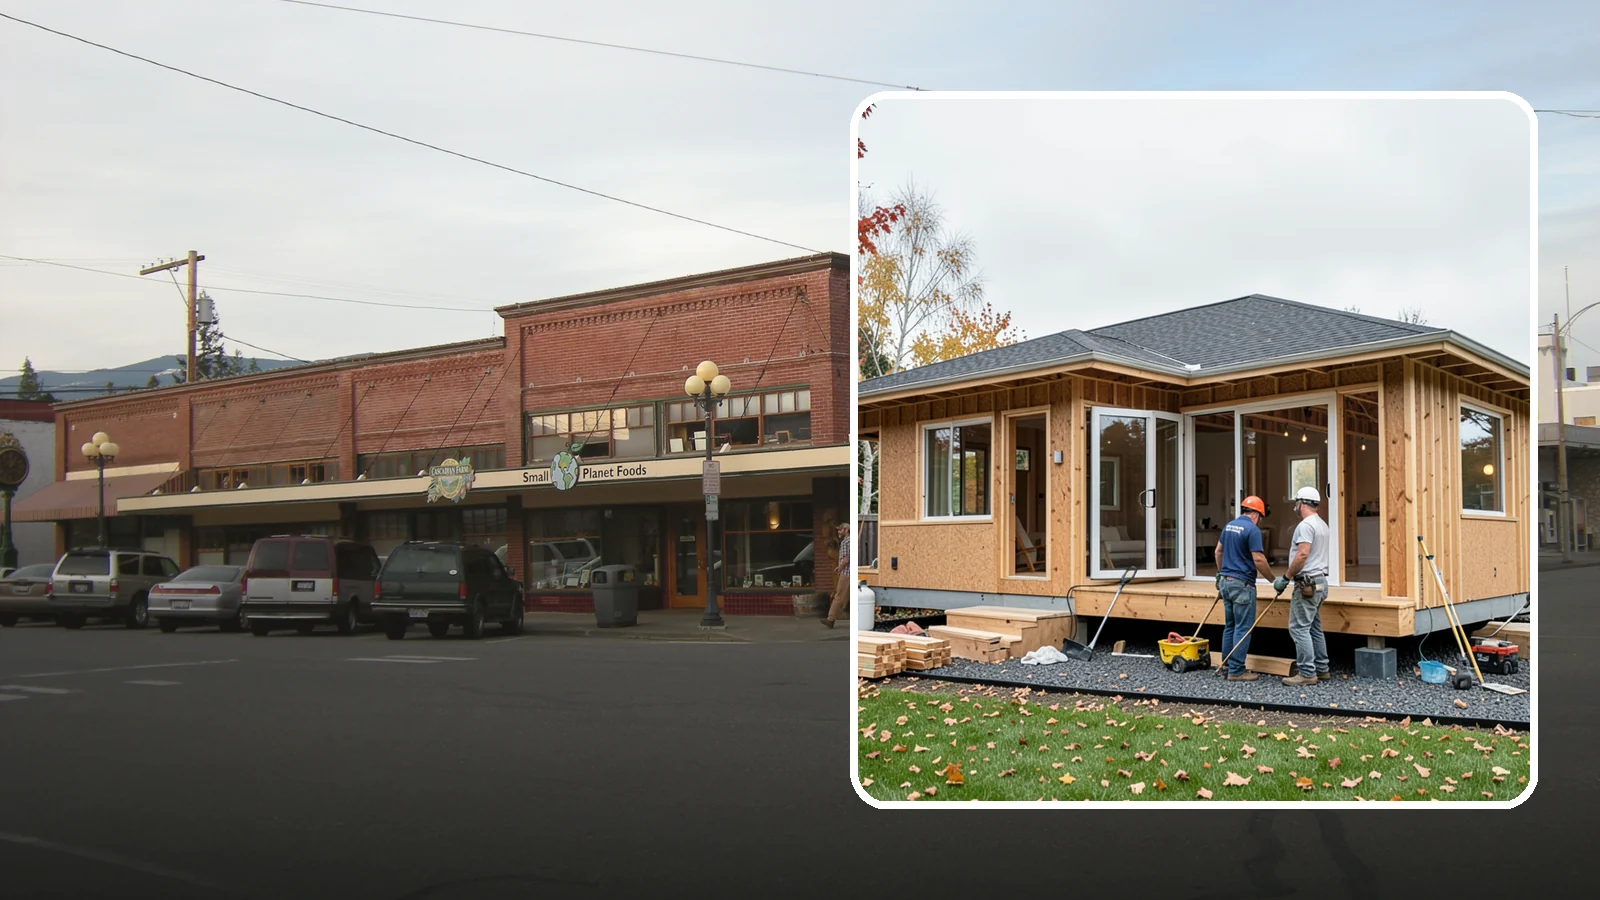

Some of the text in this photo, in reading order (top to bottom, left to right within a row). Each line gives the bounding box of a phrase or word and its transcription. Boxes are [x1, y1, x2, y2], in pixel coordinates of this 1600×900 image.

[523, 464, 647, 483] Small Planet Foods
